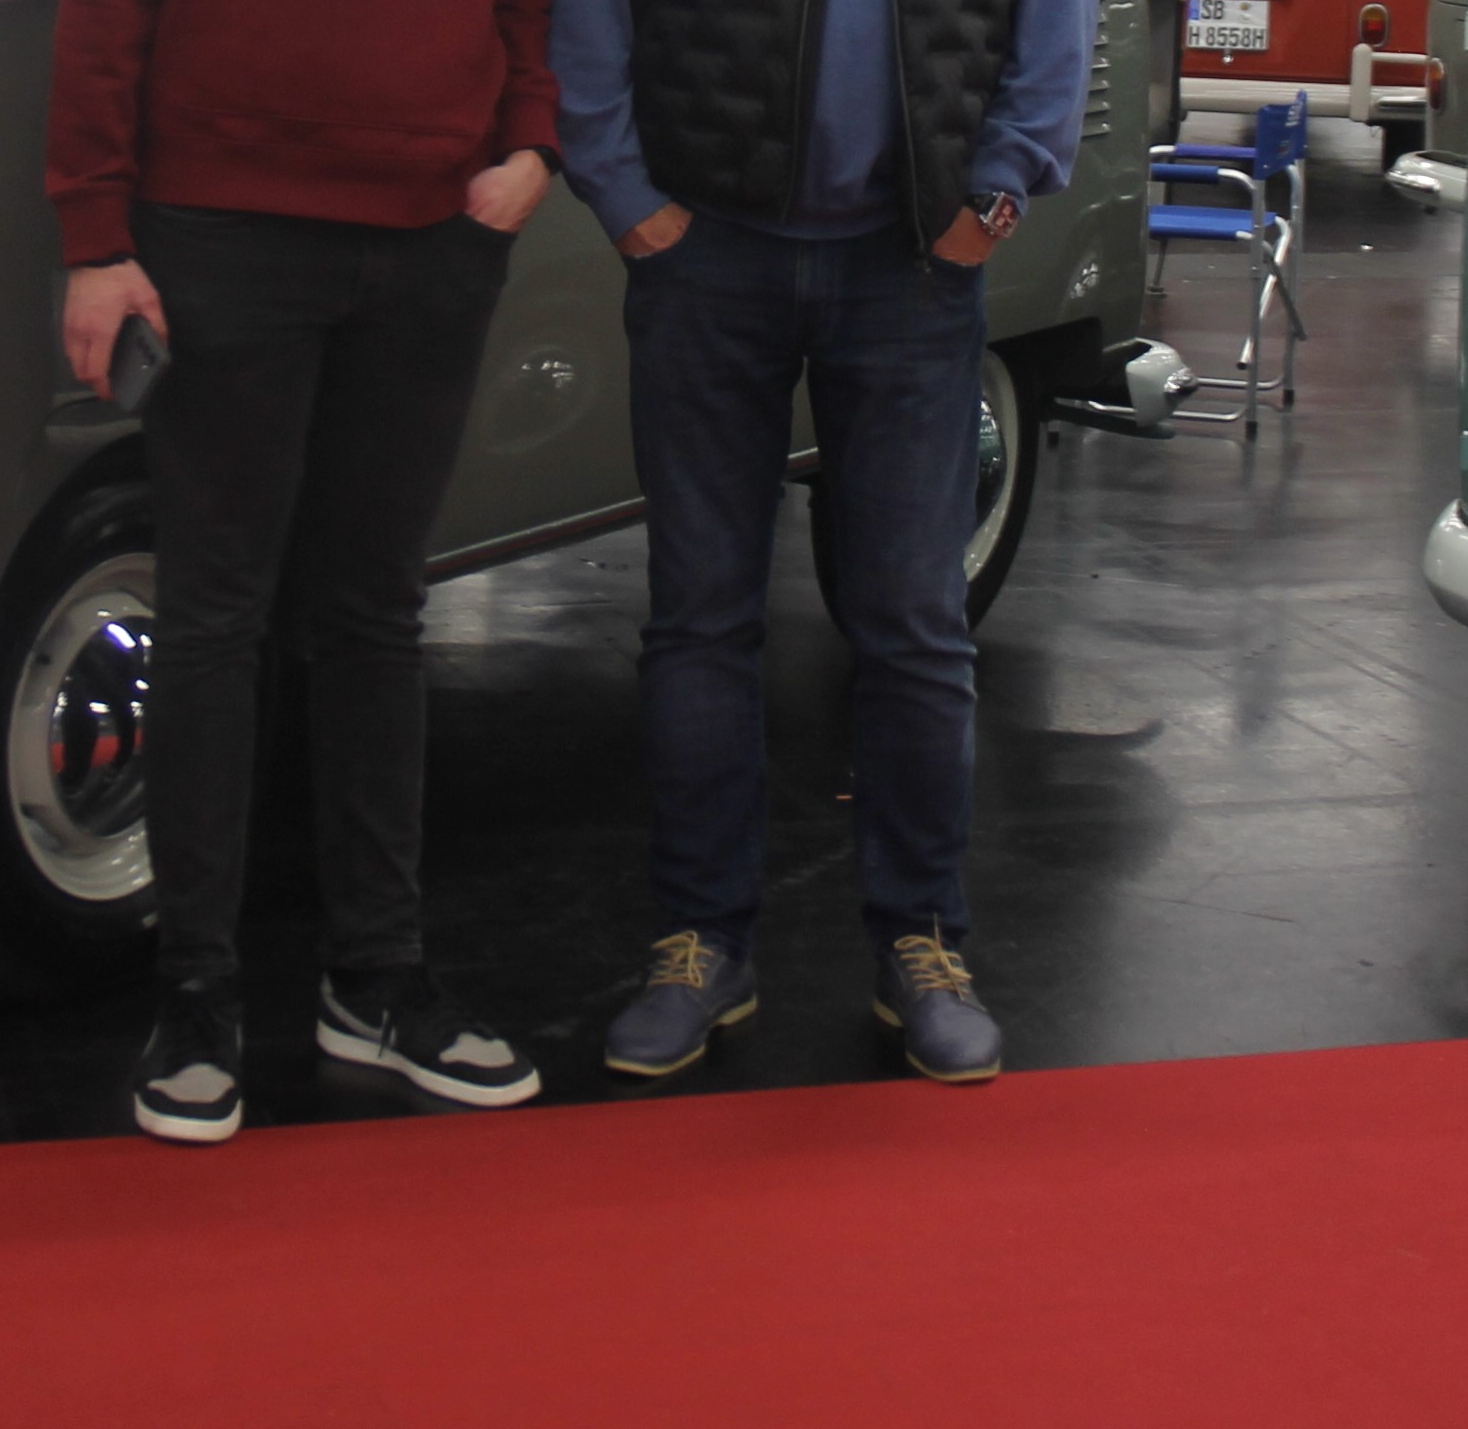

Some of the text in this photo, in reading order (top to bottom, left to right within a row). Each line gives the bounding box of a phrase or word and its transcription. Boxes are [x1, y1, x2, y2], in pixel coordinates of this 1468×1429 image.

[1201, 0, 1224, 20] SB
[1188, 26, 1265, 48] H 8558H
